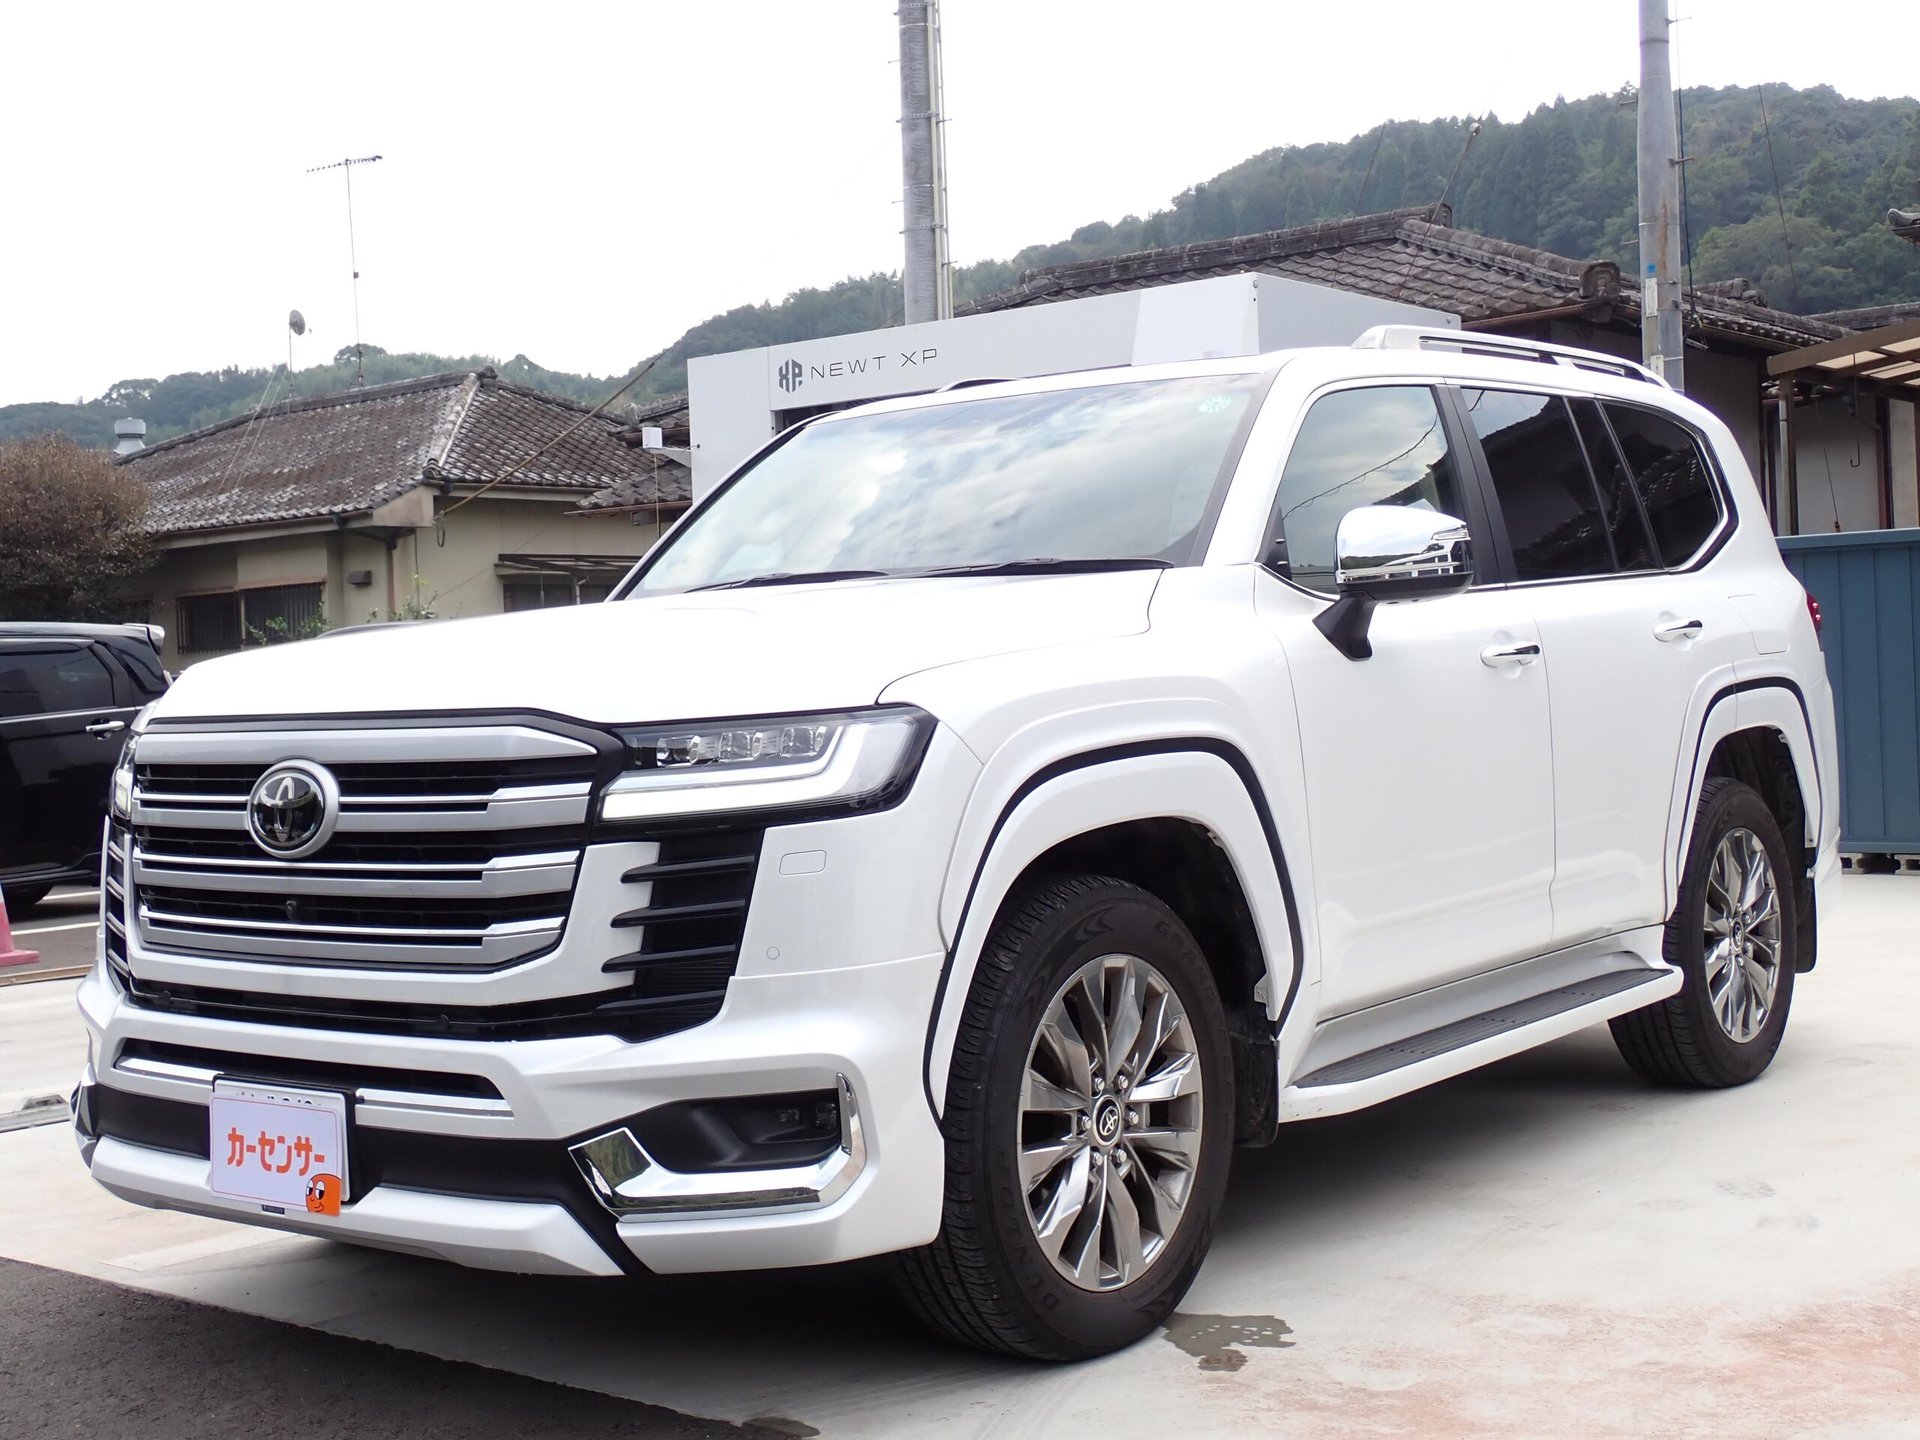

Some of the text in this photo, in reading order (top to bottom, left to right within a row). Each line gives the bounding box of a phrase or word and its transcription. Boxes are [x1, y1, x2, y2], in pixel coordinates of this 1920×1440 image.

[810, 348, 937, 380] NEWT XP
[227, 1127, 325, 1177] カーセンサー
